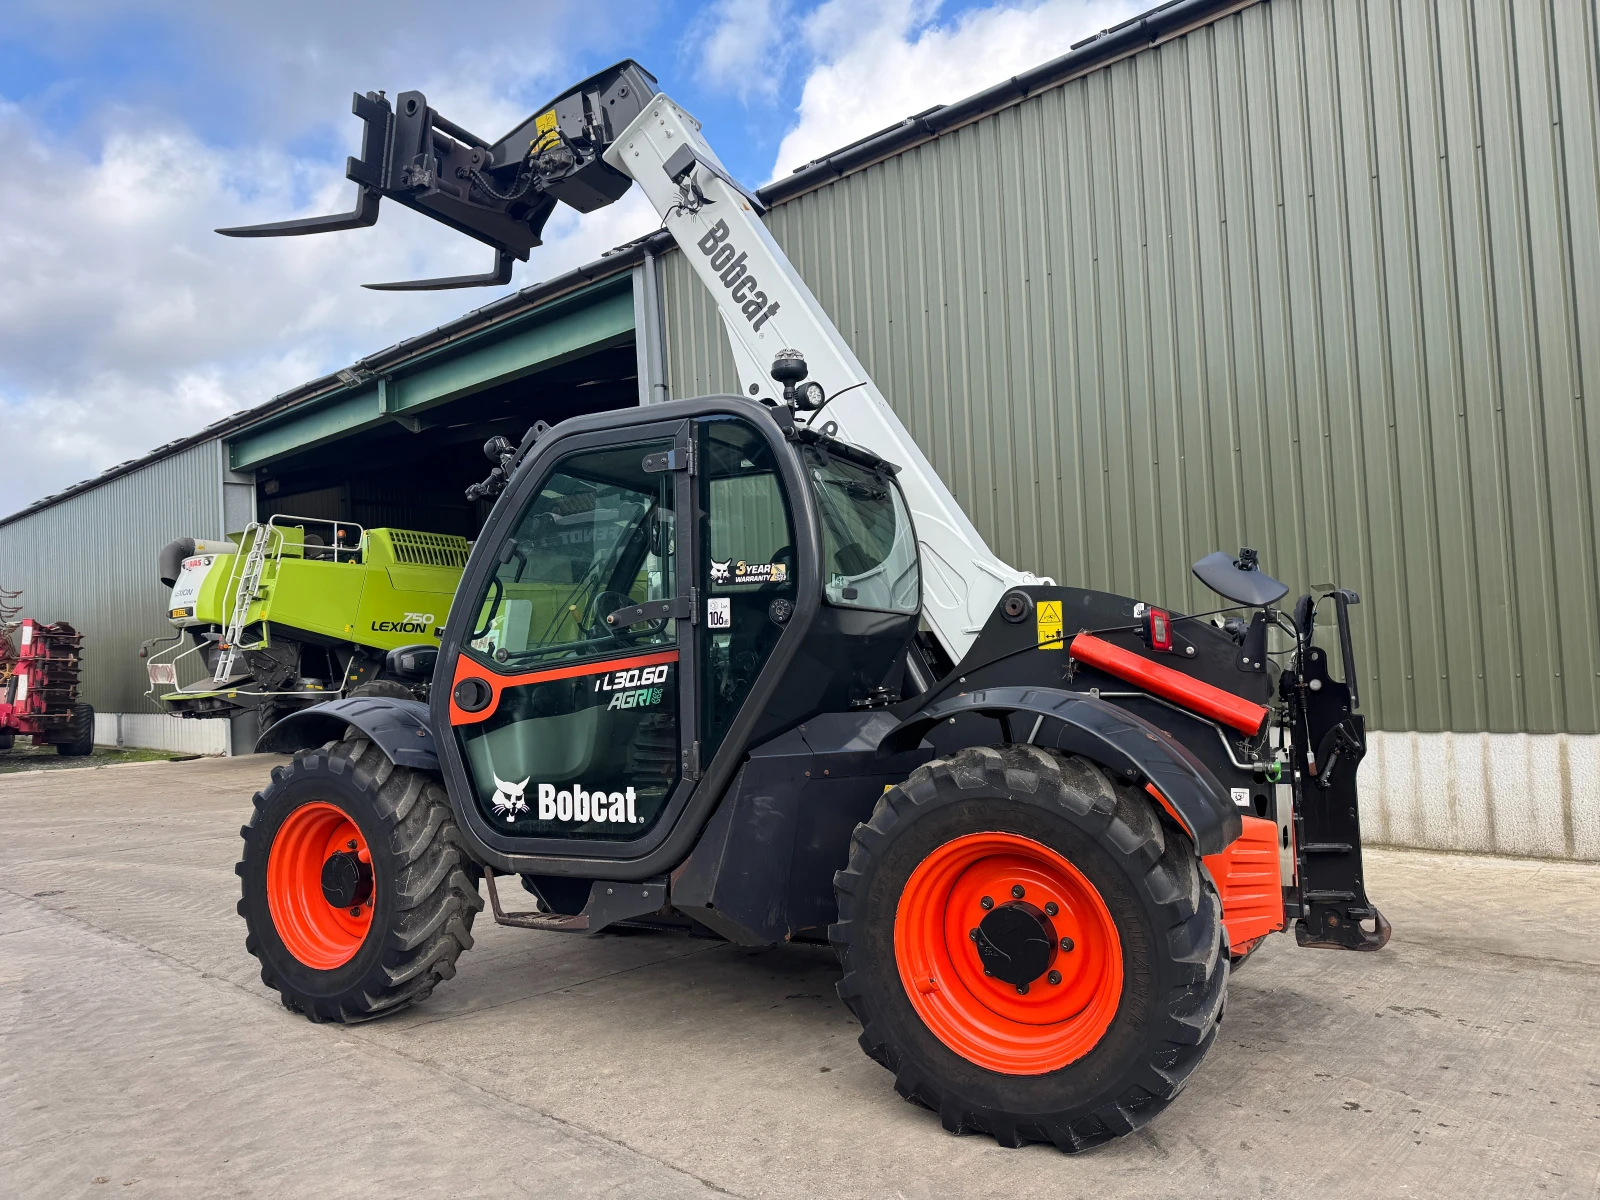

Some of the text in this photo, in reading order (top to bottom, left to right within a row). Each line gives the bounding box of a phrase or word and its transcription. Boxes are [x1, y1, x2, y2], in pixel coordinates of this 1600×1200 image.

[697, 218, 780, 333] Bobcat
[736, 560, 771, 575] 3 YEAR
[736, 574, 772, 582] WARRANTY
[402, 612, 435, 625] 750
[709, 611, 724, 626] 106
[371, 620, 427, 634] LEXION
[606, 688, 653, 711] AGRI
[538, 783, 637, 824] Bobcat
